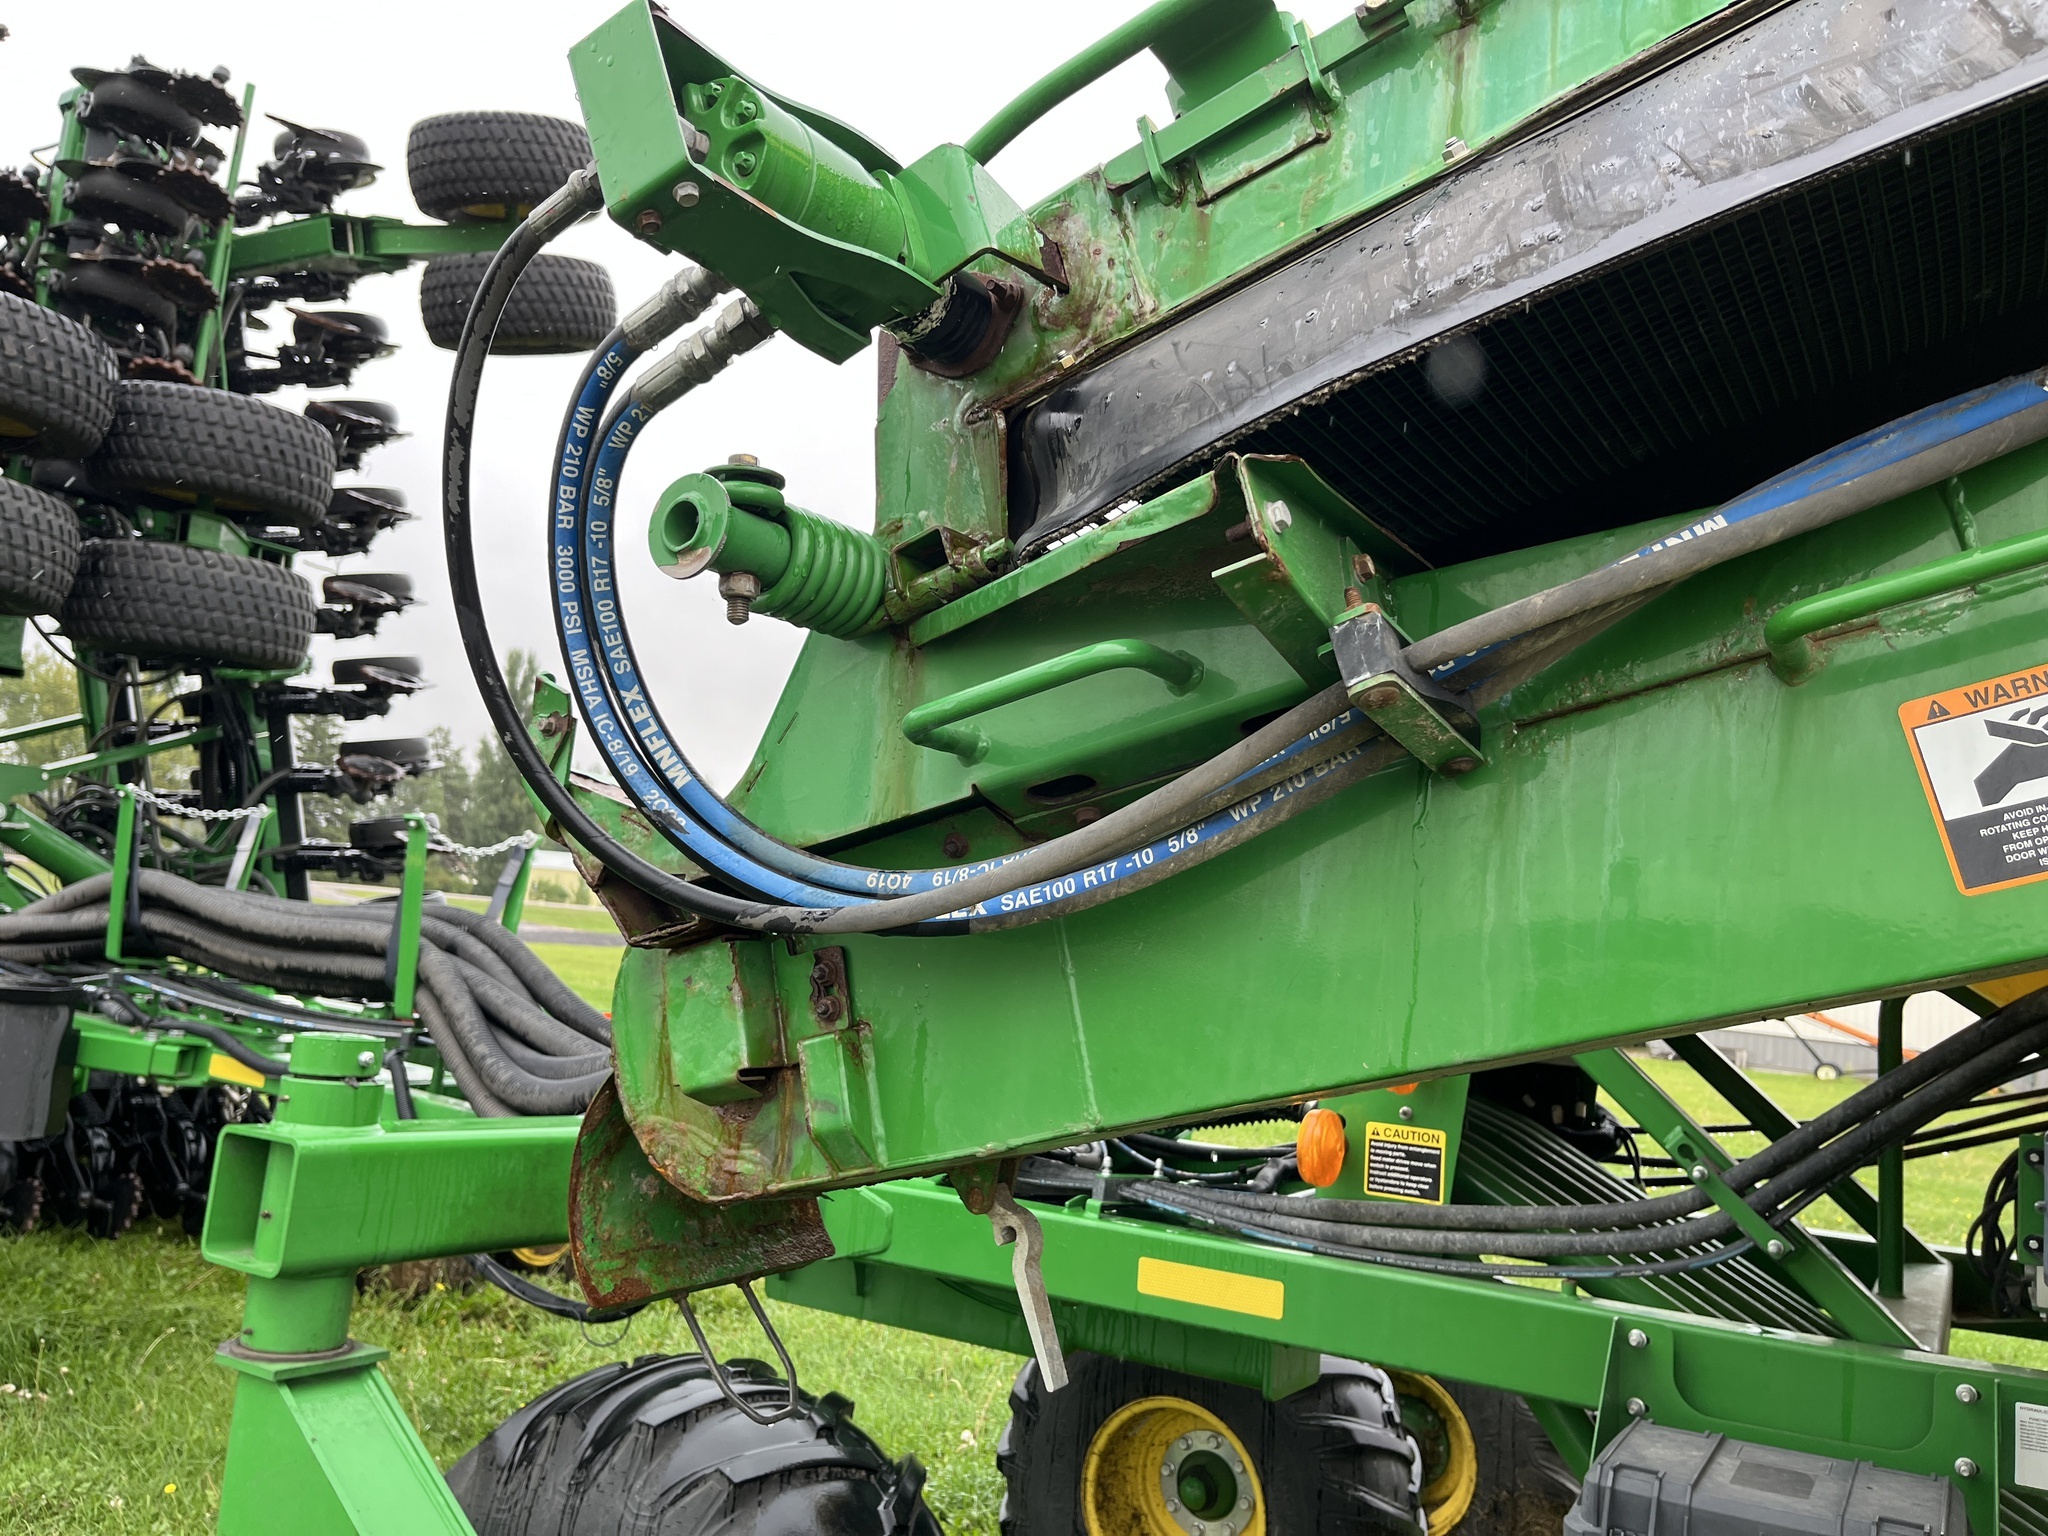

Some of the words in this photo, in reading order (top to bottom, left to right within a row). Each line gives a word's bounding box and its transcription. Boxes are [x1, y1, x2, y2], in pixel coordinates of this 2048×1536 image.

[597, 352, 624, 389] 5/8"
[572, 406, 595, 438] WP
[608, 421, 634, 449] WP
[562, 443, 583, 478] 210
[593, 467, 613, 507] 5/8"
[557, 485, 577, 530] BAR
[590, 521, 608, 549] -10
[557, 545, 576, 593] 3000
[591, 557, 611, 592] R17
[562, 601, 582, 635] PSI
[598, 600, 631, 675] SAE100
[571, 649, 603, 710] MSHA
[593, 713, 639, 777] IC-8/19
[620, 684, 692, 790] MNFLEX
[1979, 819, 2031, 837] ROTATING
[2032, 814, 2048, 824] CO
[2003, 807, 2034, 821] AVOID
[2035, 804, 2048, 814] IN
[2002, 840, 2033, 853] FROM
[2012, 827, 2039, 840] KEEP
[1000, 878, 1076, 911] SAE100
[1083, 862, 1118, 888] R17
[1125, 847, 1154, 869] -10
[1168, 822, 1205, 853] 5/8"
[1228, 794, 1261, 822] WP
[2005, 850, 2036, 863] DOOR
[866, 873, 913, 889] 4Q19
[1383, 1127, 1440, 1144] CAUTION
